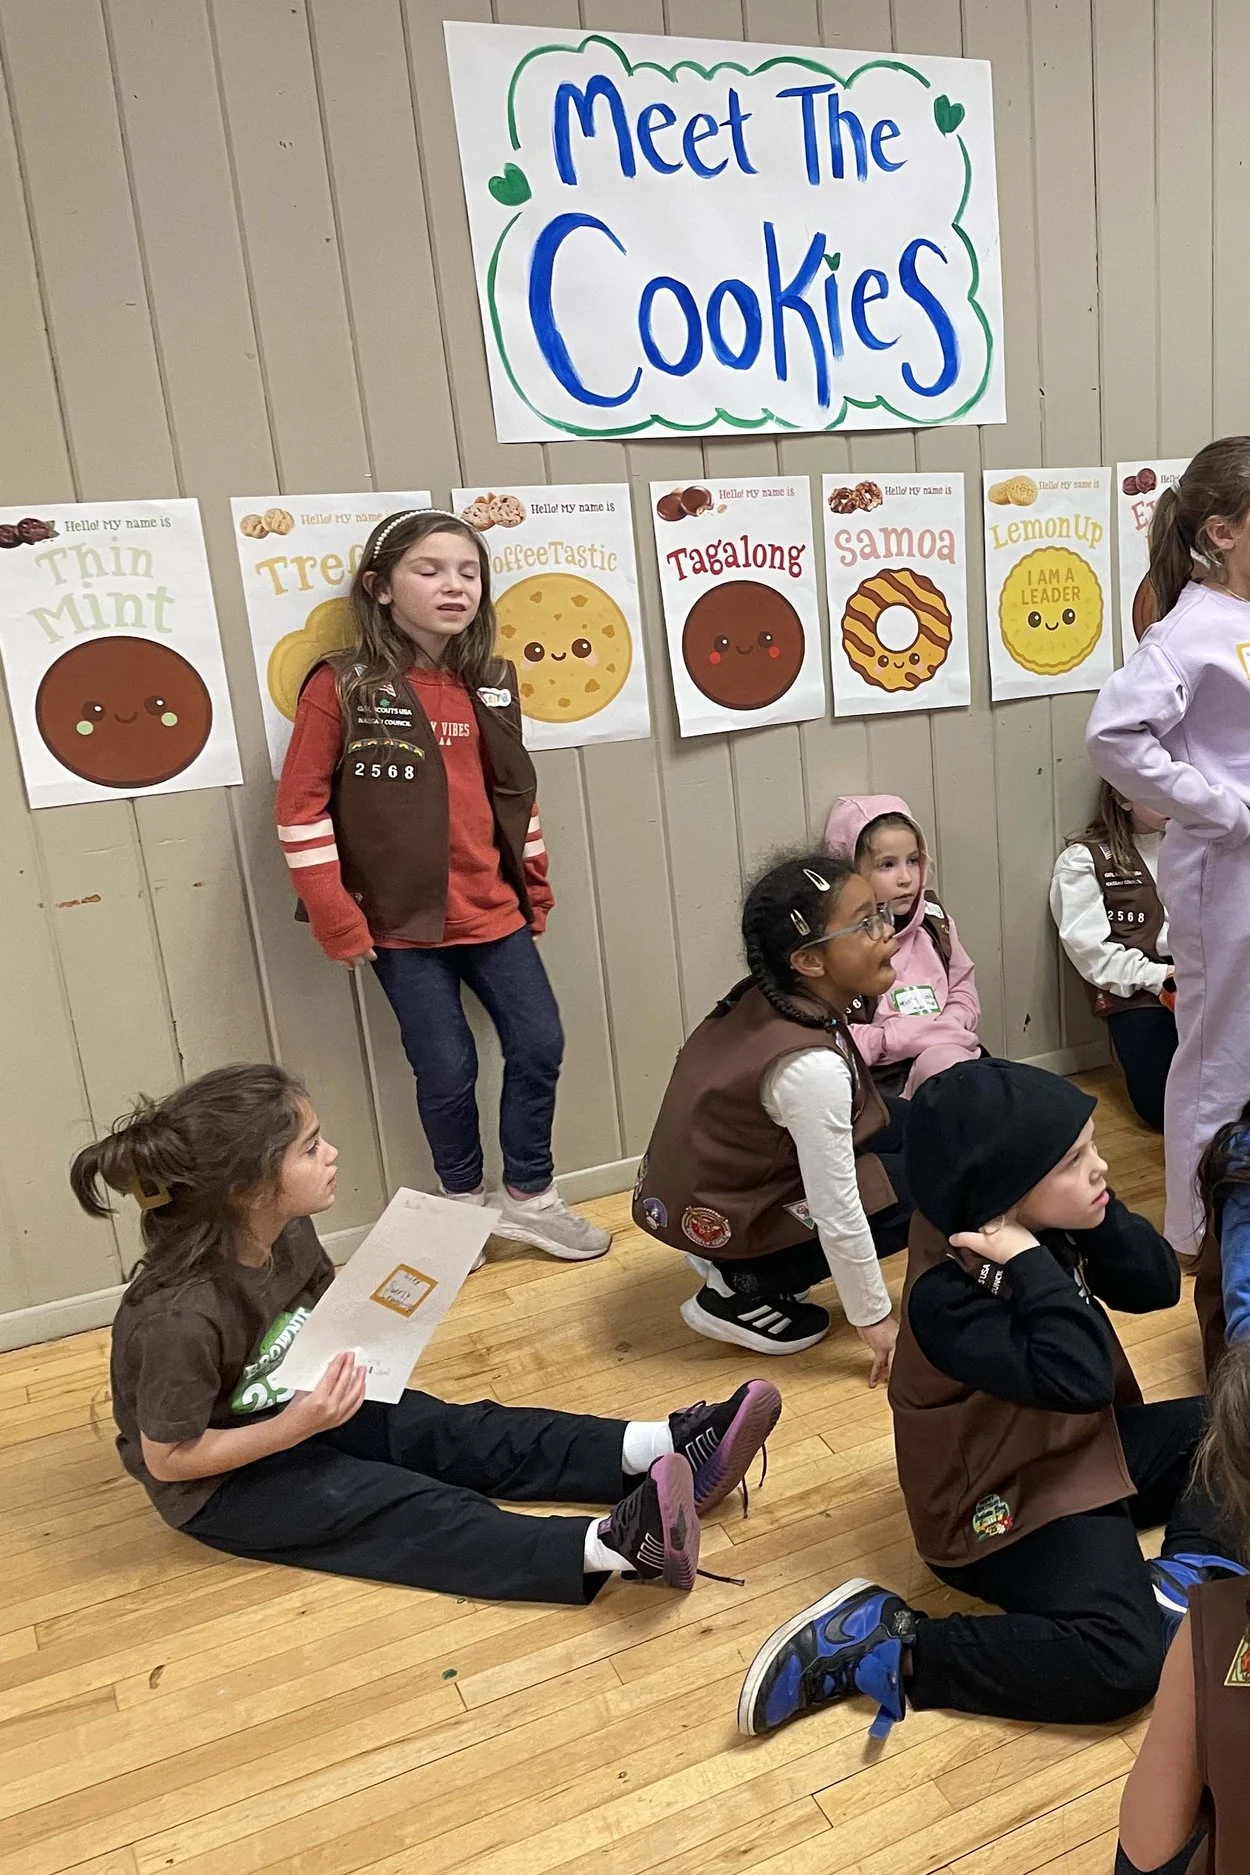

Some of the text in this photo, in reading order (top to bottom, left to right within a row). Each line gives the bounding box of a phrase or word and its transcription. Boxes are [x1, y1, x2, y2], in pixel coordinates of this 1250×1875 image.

[553, 74, 909, 185] Meet The
[719, 489, 744, 499] Hello!
[762, 488, 784, 497] name
[787, 486, 795, 497] is
[885, 486, 906, 496] Hello!
[923, 486, 943, 495] name
[945, 484, 952, 495] is
[530, 504, 558, 514] Hello!
[579, 502, 604, 512] name
[606, 500, 615, 512] is
[64, 520, 99, 532] Hello!
[126, 519, 157, 529] name
[160, 516, 171, 528] is
[355, 512, 383, 523] name
[989, 514, 1103, 550] LemonUp
[834, 527, 956, 567] Samoa
[34, 536, 153, 585] Thin
[491, 541, 617, 574] offeeTastic
[666, 534, 806, 582] Tagalong
[1028, 567, 1075, 586] I AM A
[1022, 586, 1081, 605] LEADER
[27, 581, 176, 644] Mint
[384, 719, 412, 727] COUNCIL
[441, 722, 470, 737] VIBES
[355, 763, 415, 780] 2568
[1108, 910, 1145, 923] 2568
